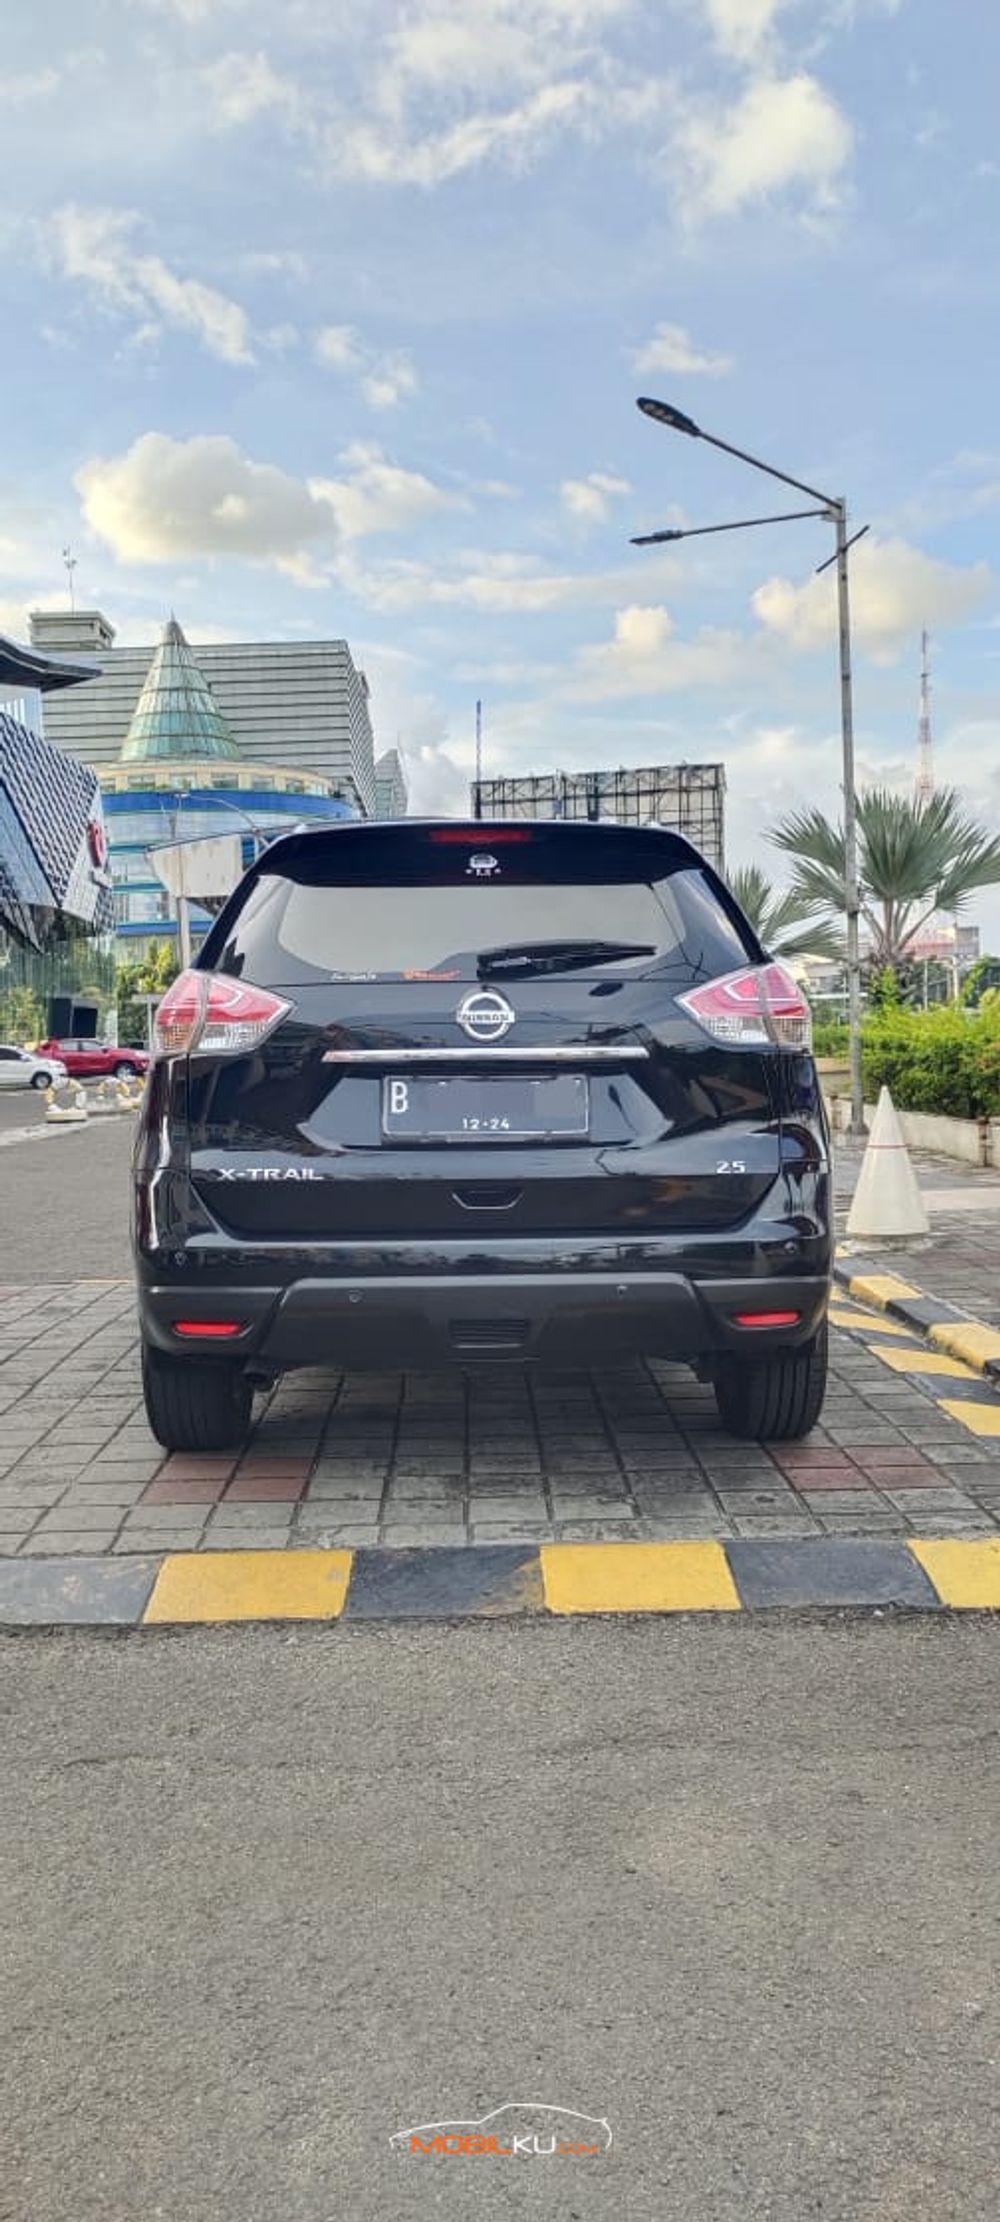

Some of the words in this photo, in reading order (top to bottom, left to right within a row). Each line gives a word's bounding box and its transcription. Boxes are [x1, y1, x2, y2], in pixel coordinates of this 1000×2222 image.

[462, 1013, 509, 1021] NISSAN
[390, 1081, 409, 1113] B
[216, 1168, 324, 1180] X-TRAIL
